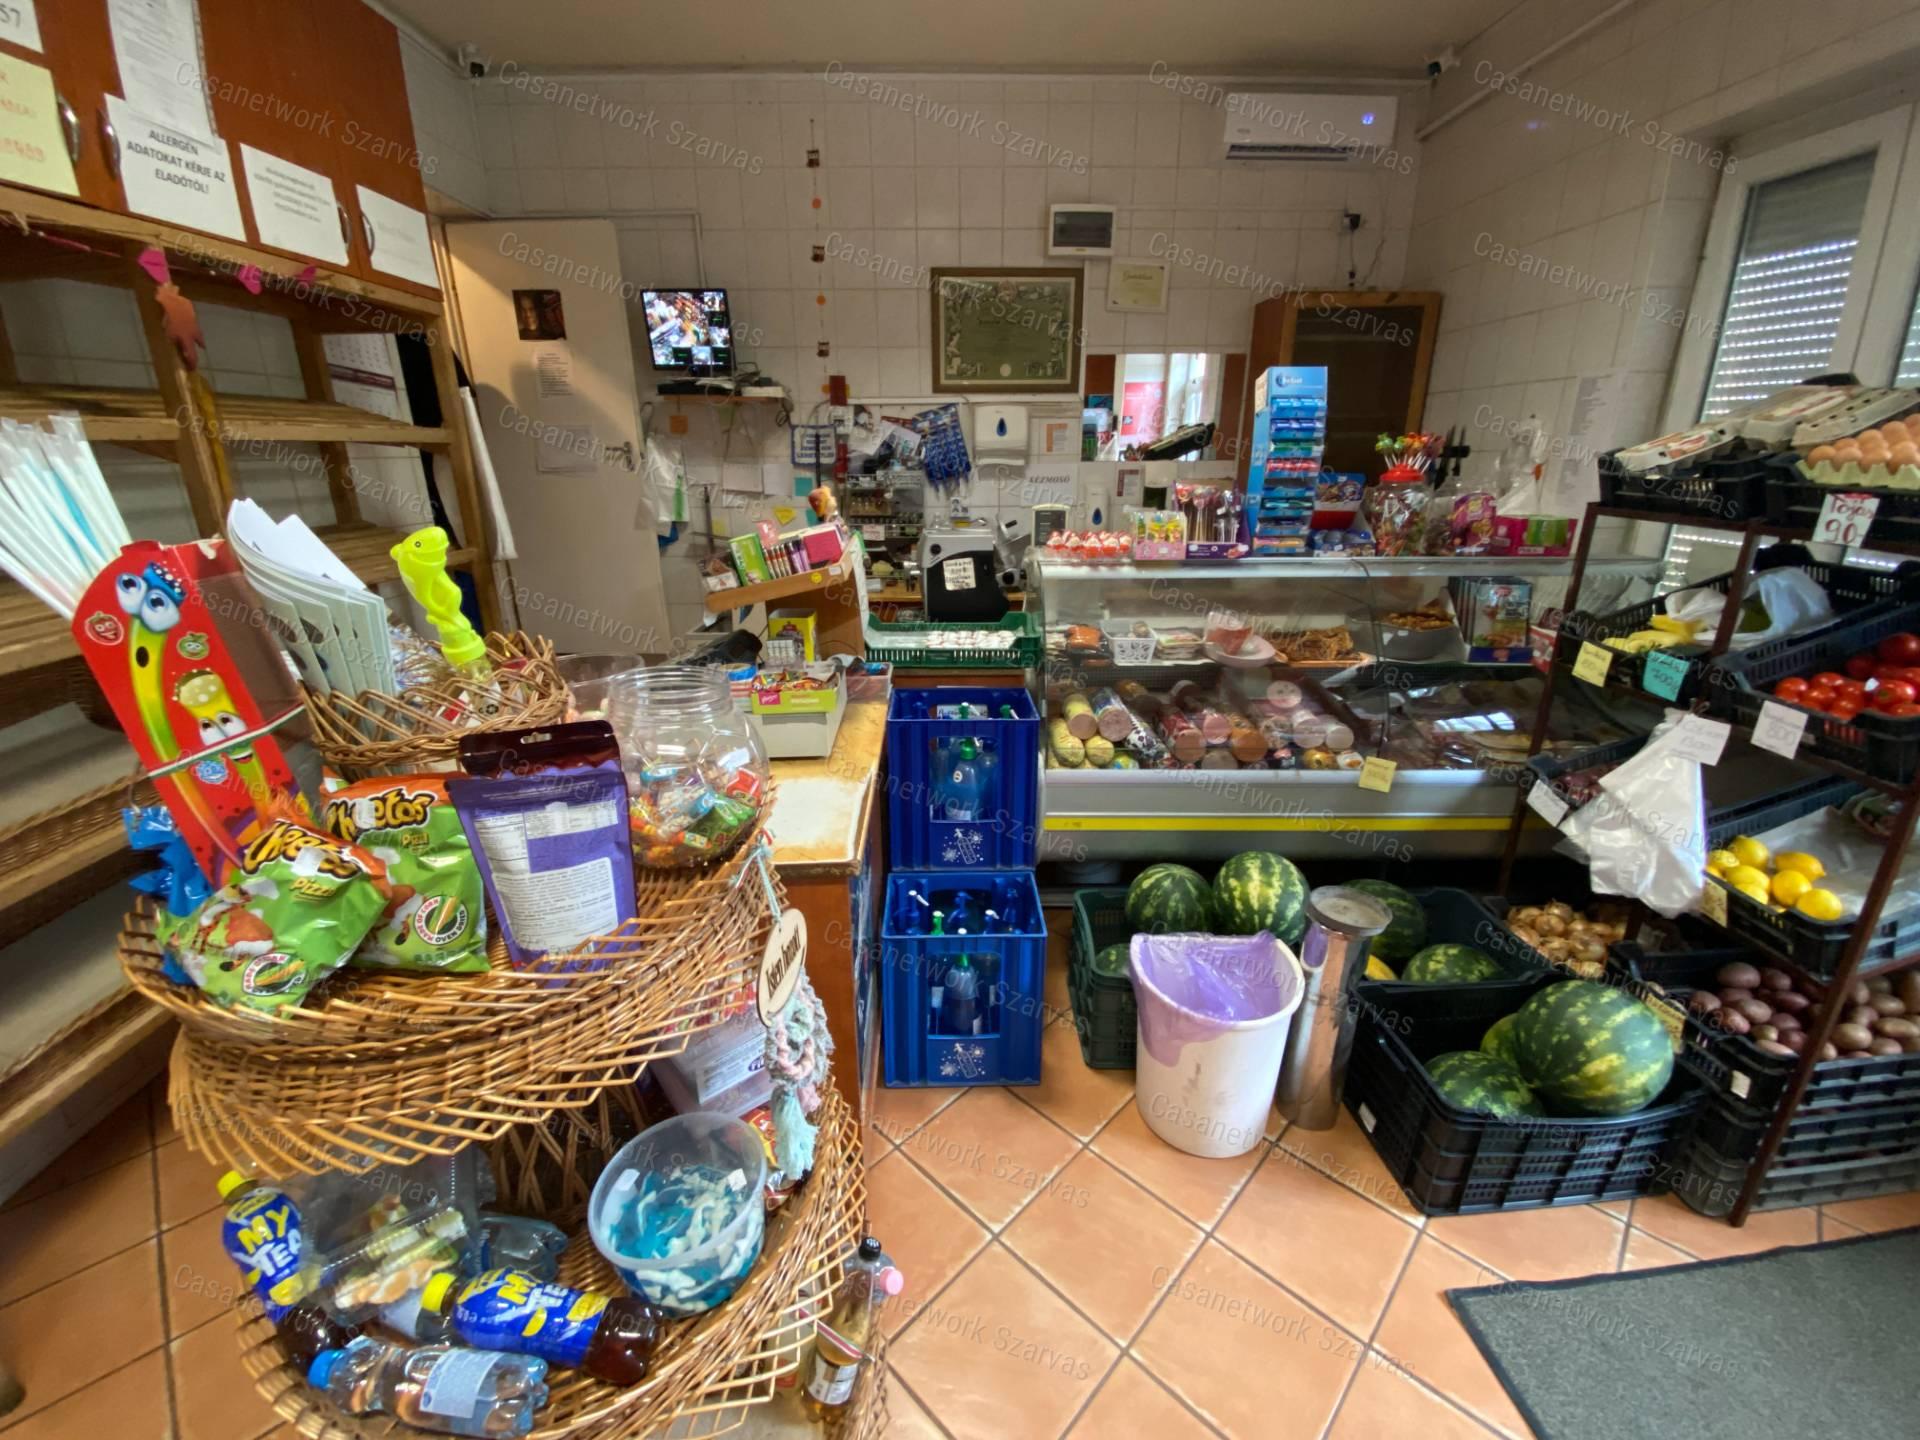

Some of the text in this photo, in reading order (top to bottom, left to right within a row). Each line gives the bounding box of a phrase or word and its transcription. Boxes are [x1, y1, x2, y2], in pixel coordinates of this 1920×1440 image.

[127, 141, 226, 183] ADATOKAT KÉRJE AZ
[149, 129, 199, 156] ALLERGÉN
[155, 168, 210, 195] ELADÓTÓL!
[326, 788, 435, 842] Chetos
[238, 1205, 289, 1255] MY
[231, 1228, 303, 1278] TEA
[497, 1272, 538, 1306] M
